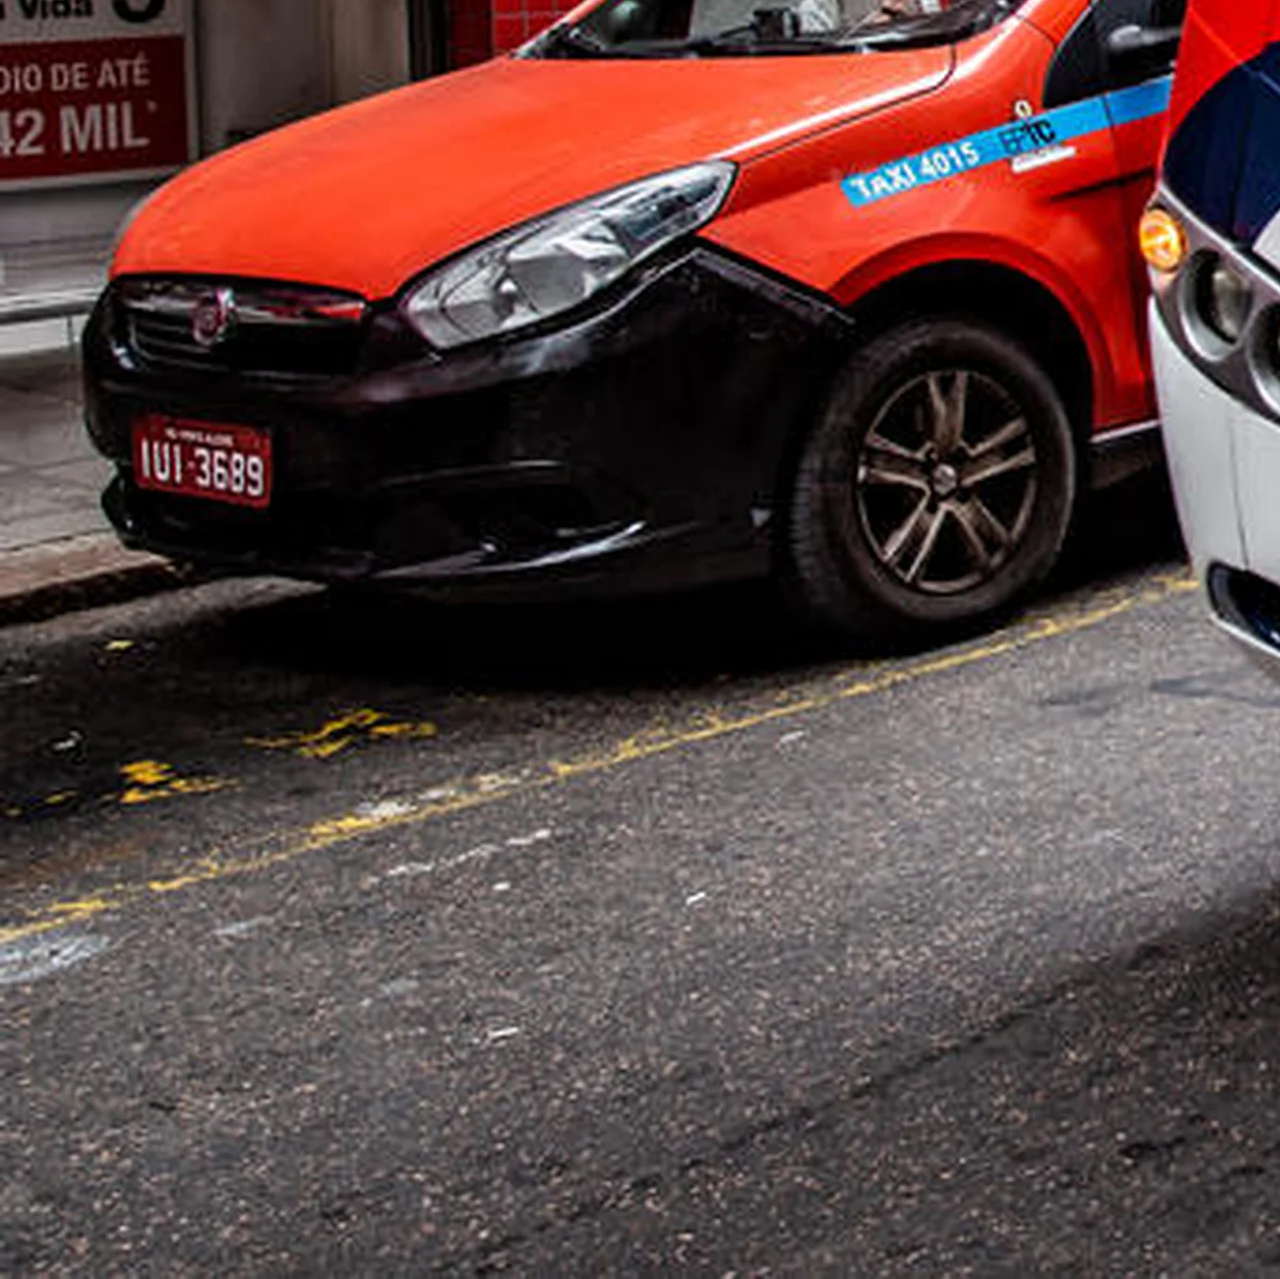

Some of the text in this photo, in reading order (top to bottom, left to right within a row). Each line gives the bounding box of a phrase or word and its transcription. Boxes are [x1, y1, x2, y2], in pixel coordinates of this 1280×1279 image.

[50, 62, 89, 92] DE
[97, 50, 151, 89] ATÉ
[919, 141, 980, 178] 4015
